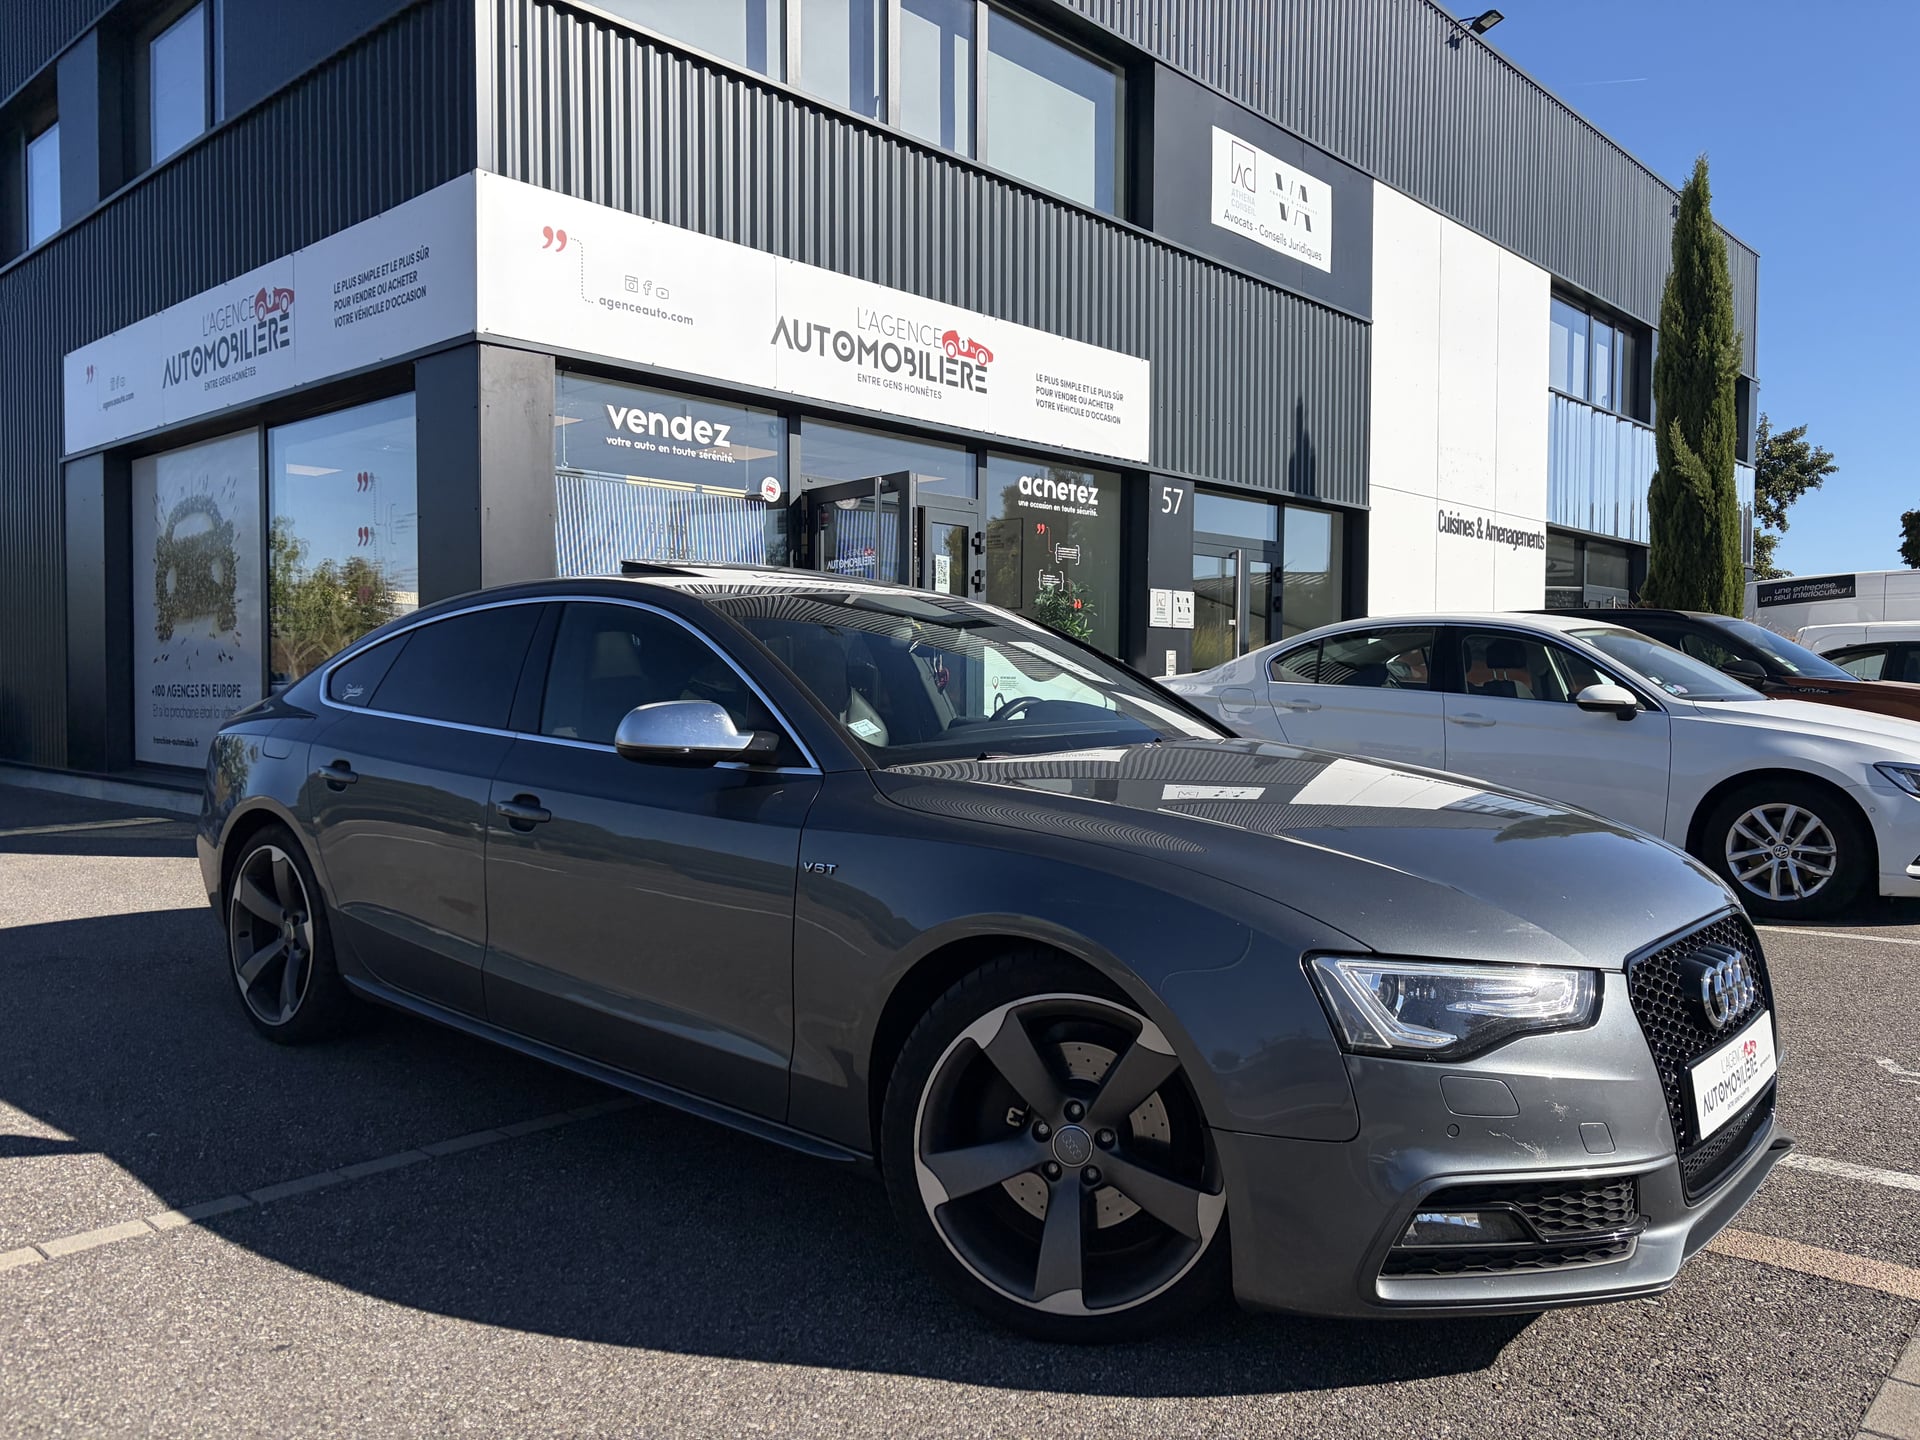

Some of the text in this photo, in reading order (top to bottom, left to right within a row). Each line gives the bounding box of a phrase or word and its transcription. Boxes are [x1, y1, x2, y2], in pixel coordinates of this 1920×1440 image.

[1224, 209, 1253, 231] Avocats
[1259, 224, 1287, 247] Conseils
[1289, 238, 1322, 261] Juridiques
[334, 245, 430, 294] LE PLUS SIMPLE ET LE PLUS SÛR
[334, 270, 418, 312] POUR VENDRE OU ACHETER
[202, 294, 256, 336] L'AGENCE
[334, 285, 427, 328] VOTRE VÉHICULE D'OCCASION
[598, 297, 694, 326] agenceauto.com
[857, 306, 942, 350] L'AGENCE
[204, 380, 218, 391] ENTRE
[219, 376, 231, 387] GENS
[857, 373, 942, 400] ENTRE GENS HONNÊTES
[1036, 373, 1043, 382] LE
[1044, 375, 1059, 386] PLUS
[1060, 379, 1081, 392] SIMPLE
[1082, 384, 1089, 393] ET
[1090, 386, 1097, 395] LE
[1098, 388, 1111, 399] PLUS
[1036, 386, 1114, 411] POUR VENDRE OU ACHETER
[1036, 398, 1121, 425] VOTRE VÉHICULE D'OCCASION
[606, 404, 731, 448] vendez
[606, 436, 736, 464] votre auto en toute sérénité.
[1029, 501, 1053, 510] occasion
[1061, 505, 1075, 514] toute
[1161, 486, 1184, 515] 57
[1438, 509, 1475, 538] Cuisines
[1476, 516, 1483, 539] &
[1761, 595, 1772, 603] un
[1774, 593, 1791, 601] seul
[1792, 587, 1847, 599] interlocuteur
[1774, 587, 1791, 595] une
[152, 684, 242, 698] +100 AGENCES EN EUROPE
[804, 862, 836, 875] V6T
